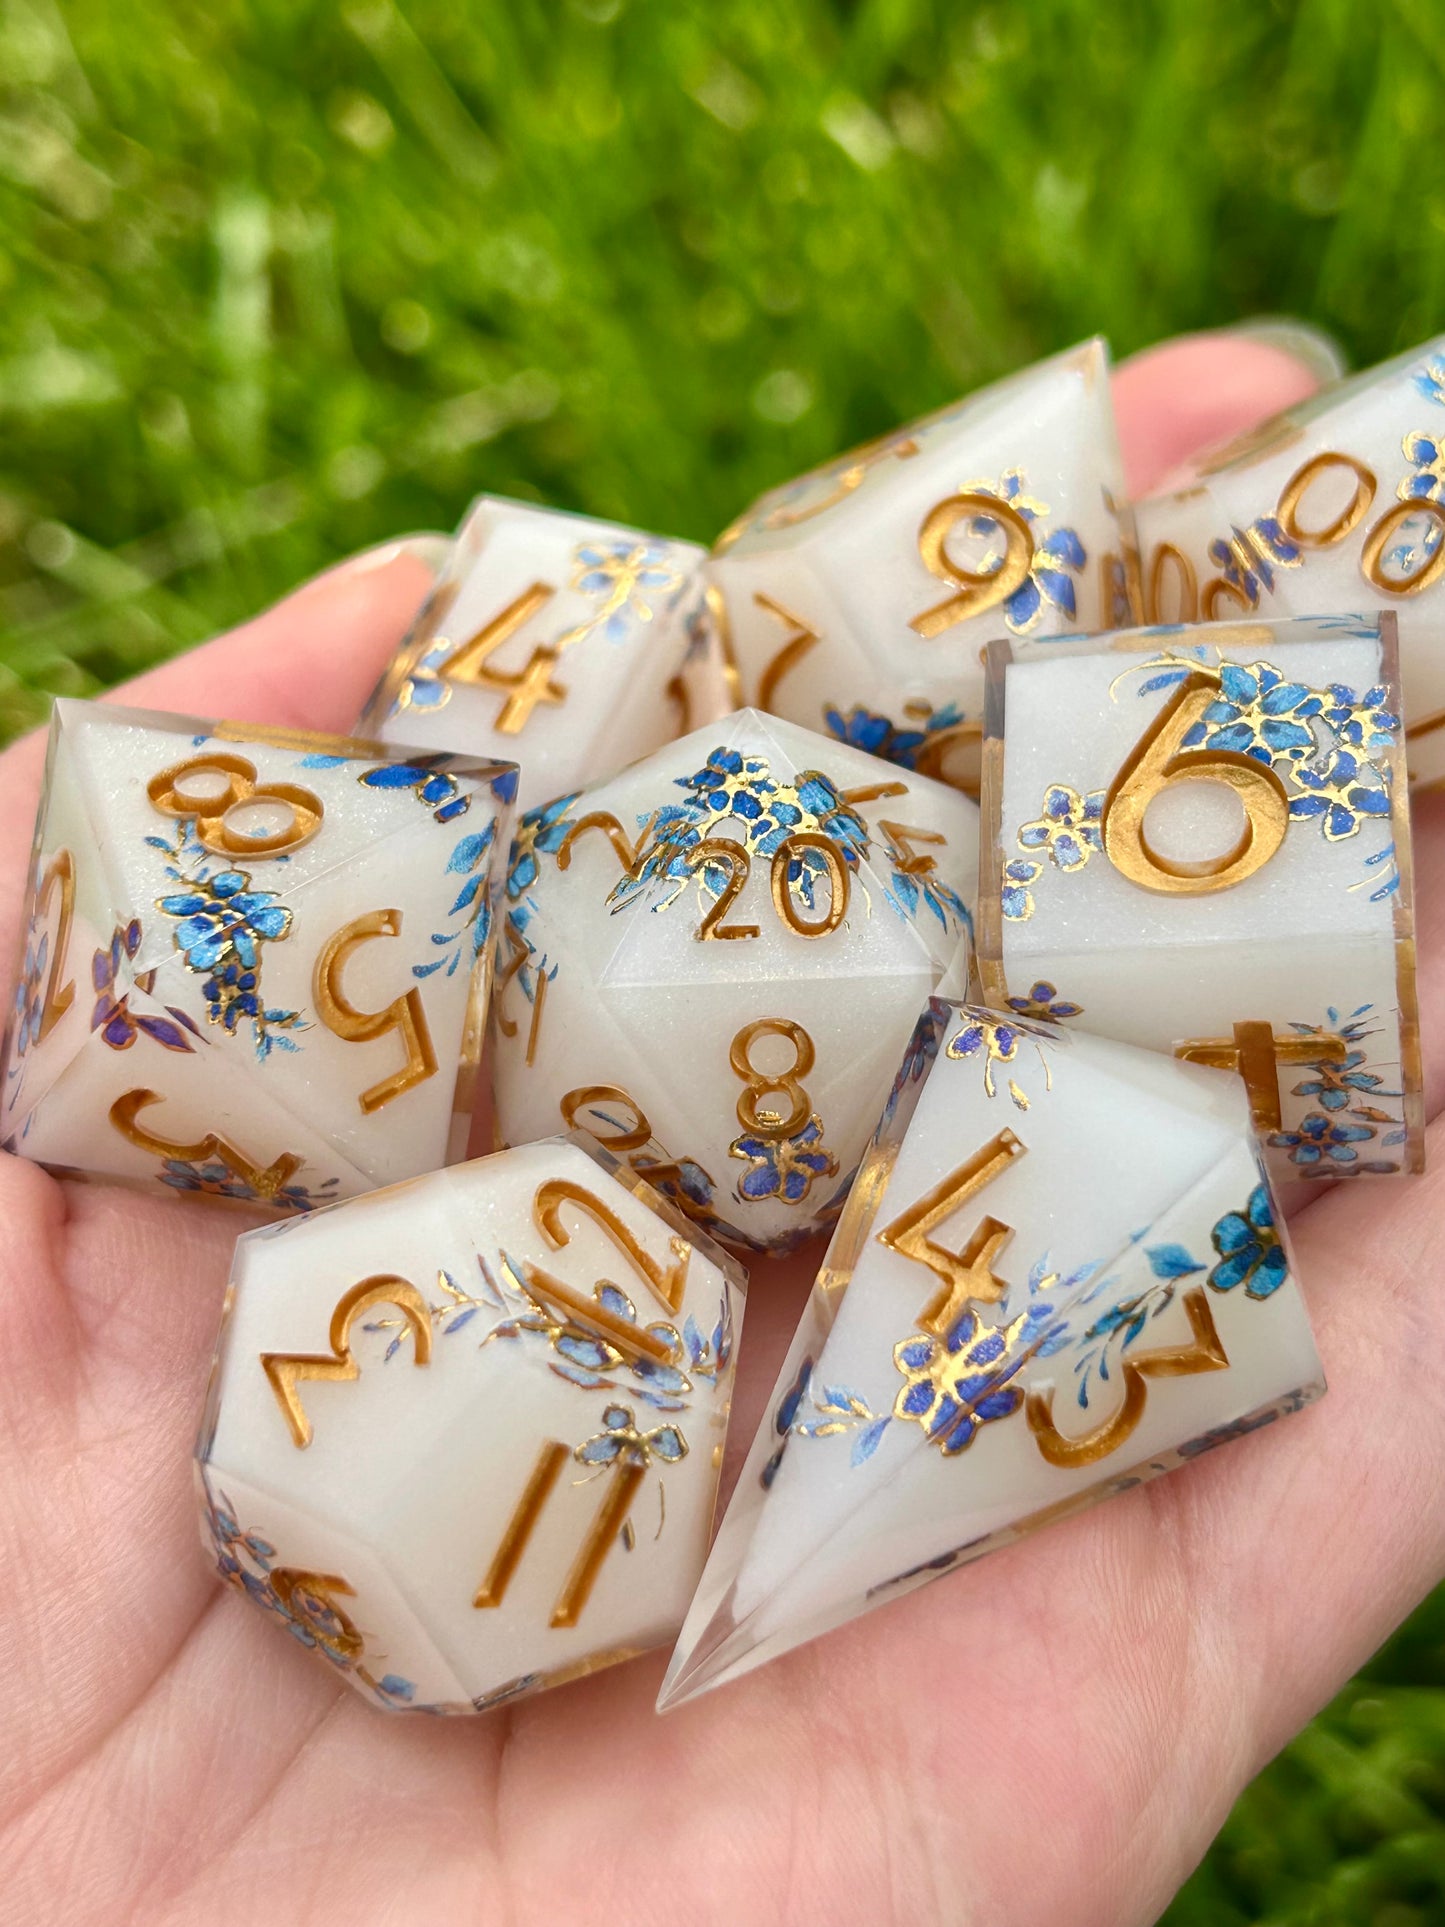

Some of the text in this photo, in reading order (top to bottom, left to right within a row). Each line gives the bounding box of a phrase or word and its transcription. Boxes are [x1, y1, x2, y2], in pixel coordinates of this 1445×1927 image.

[440, 580, 566, 735] 4
[146, 752, 325, 862] 8
[556, 810, 662, 879] 2
[1104, 669, 1290, 897] 6
[34, 847, 77, 1047] 2
[686, 832, 852, 942] 20
[311, 908, 440, 1116] 5
[730, 1015, 816, 1140] 8
[522, 1177, 692, 1364] 12
[875, 1126, 1031, 1338] 4
[260, 1272, 432, 1450] 3
[1024, 1285, 1231, 1469] 3
[473, 1438, 646, 1629] 11
